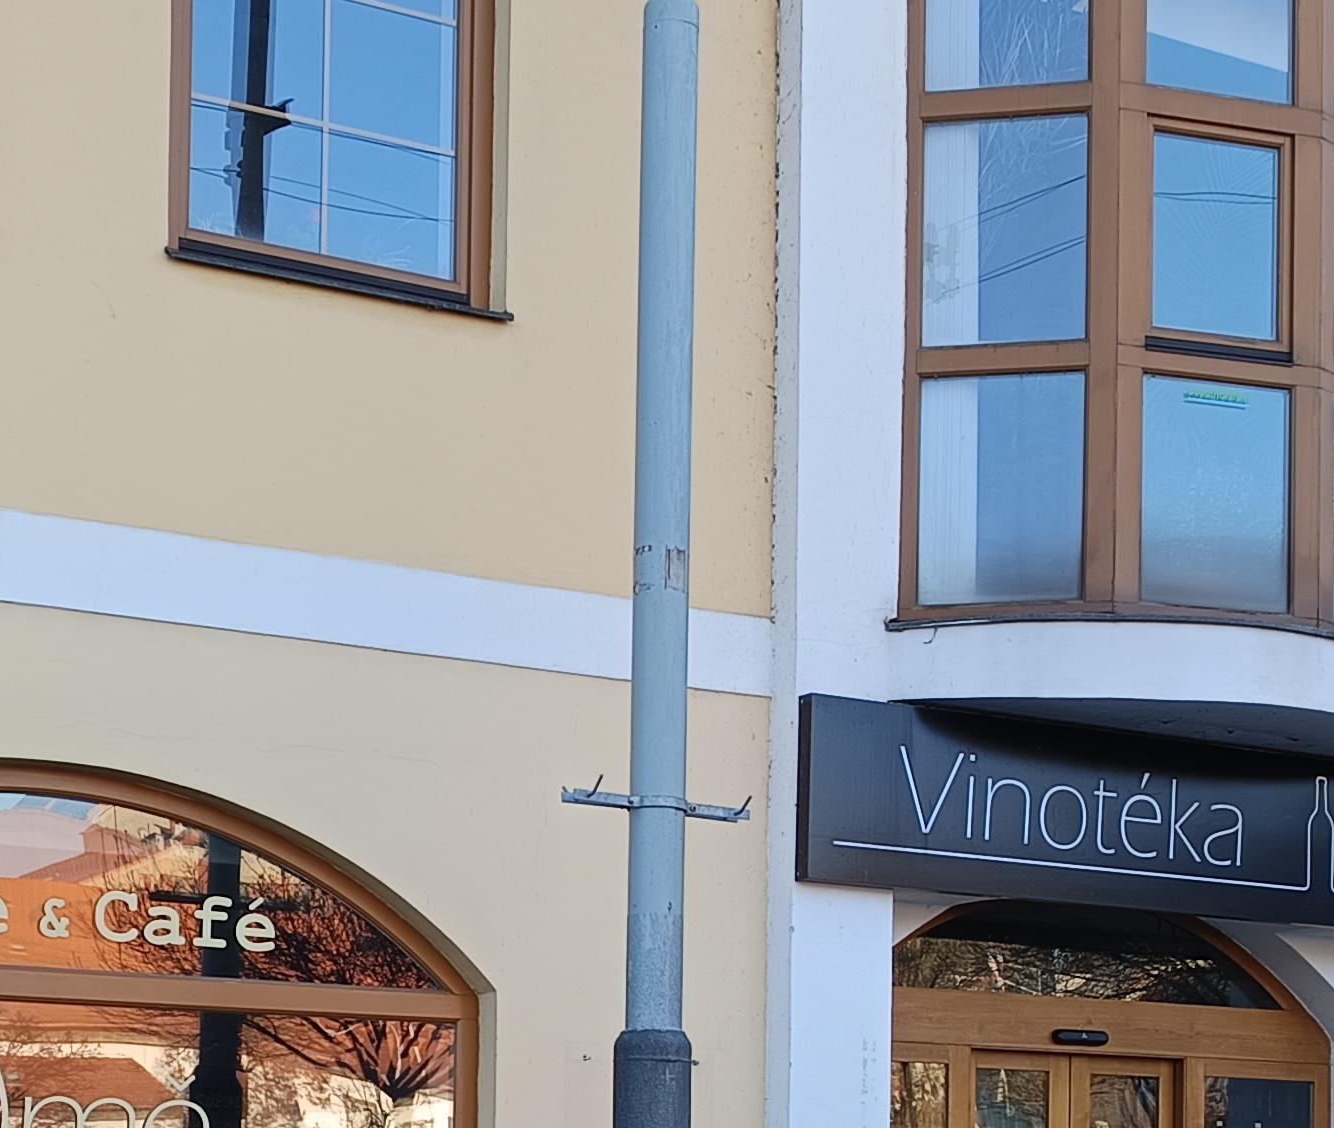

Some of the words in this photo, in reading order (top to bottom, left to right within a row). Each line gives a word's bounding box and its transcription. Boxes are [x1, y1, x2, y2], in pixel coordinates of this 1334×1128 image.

[899, 745, 1244, 867] Vinotéka
[39, 898, 70, 939] &
[94, 889, 277, 952] Café
